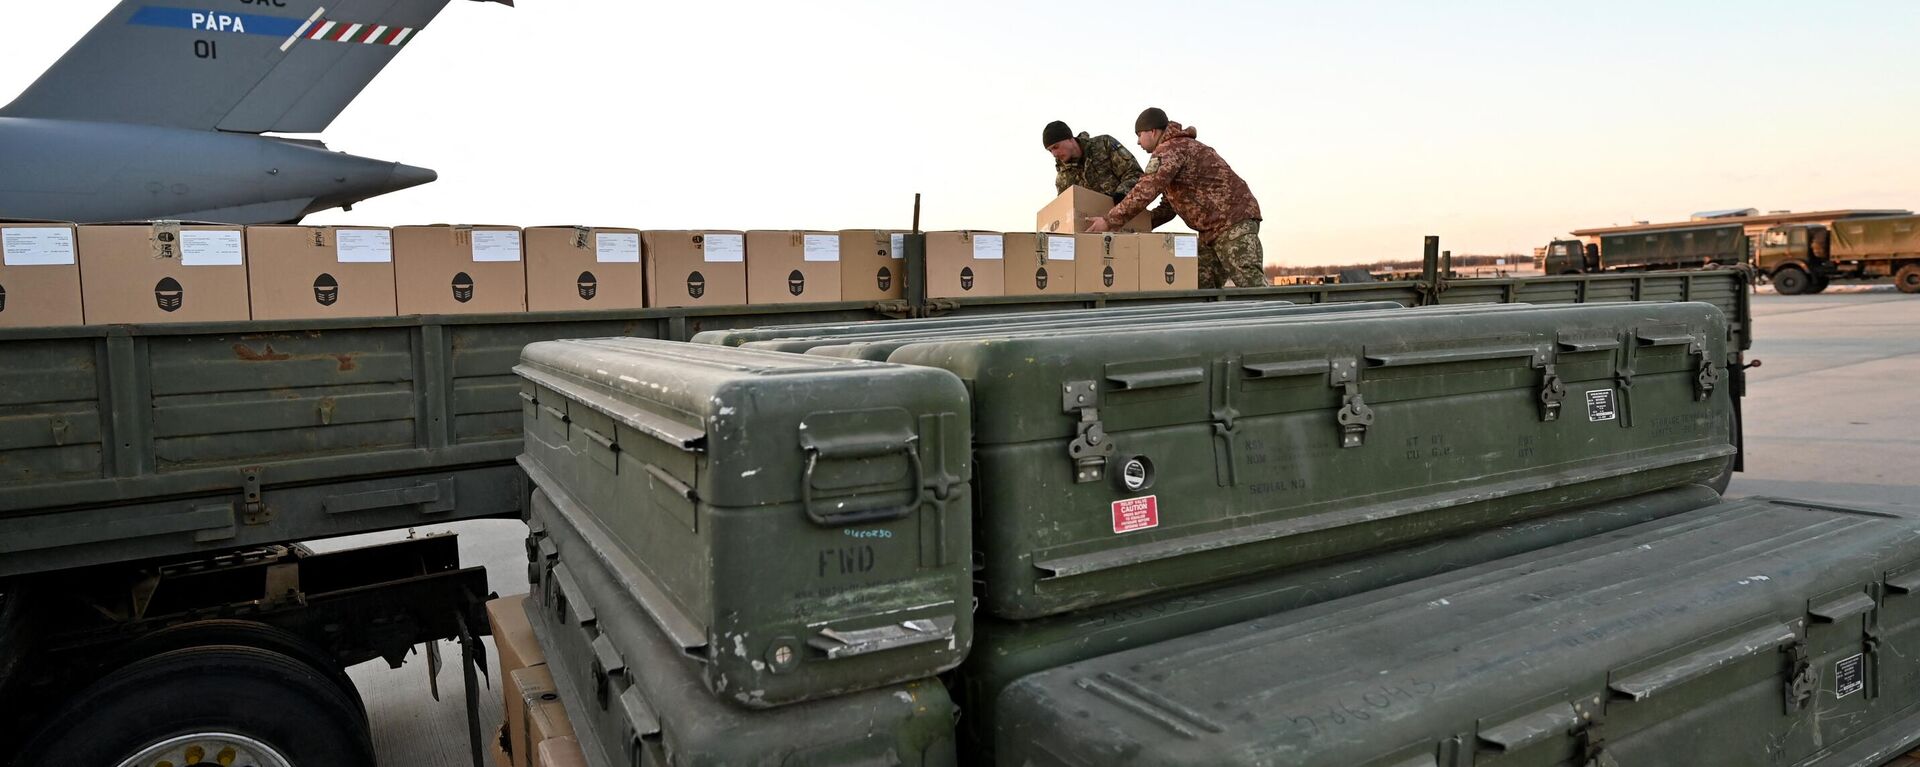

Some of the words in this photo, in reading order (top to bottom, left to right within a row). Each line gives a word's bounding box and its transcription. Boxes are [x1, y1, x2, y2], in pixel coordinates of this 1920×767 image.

[191, 11, 245, 33] PÁPA
[194, 40, 217, 59] 01
[1121, 503, 1148, 513] CAUTION
